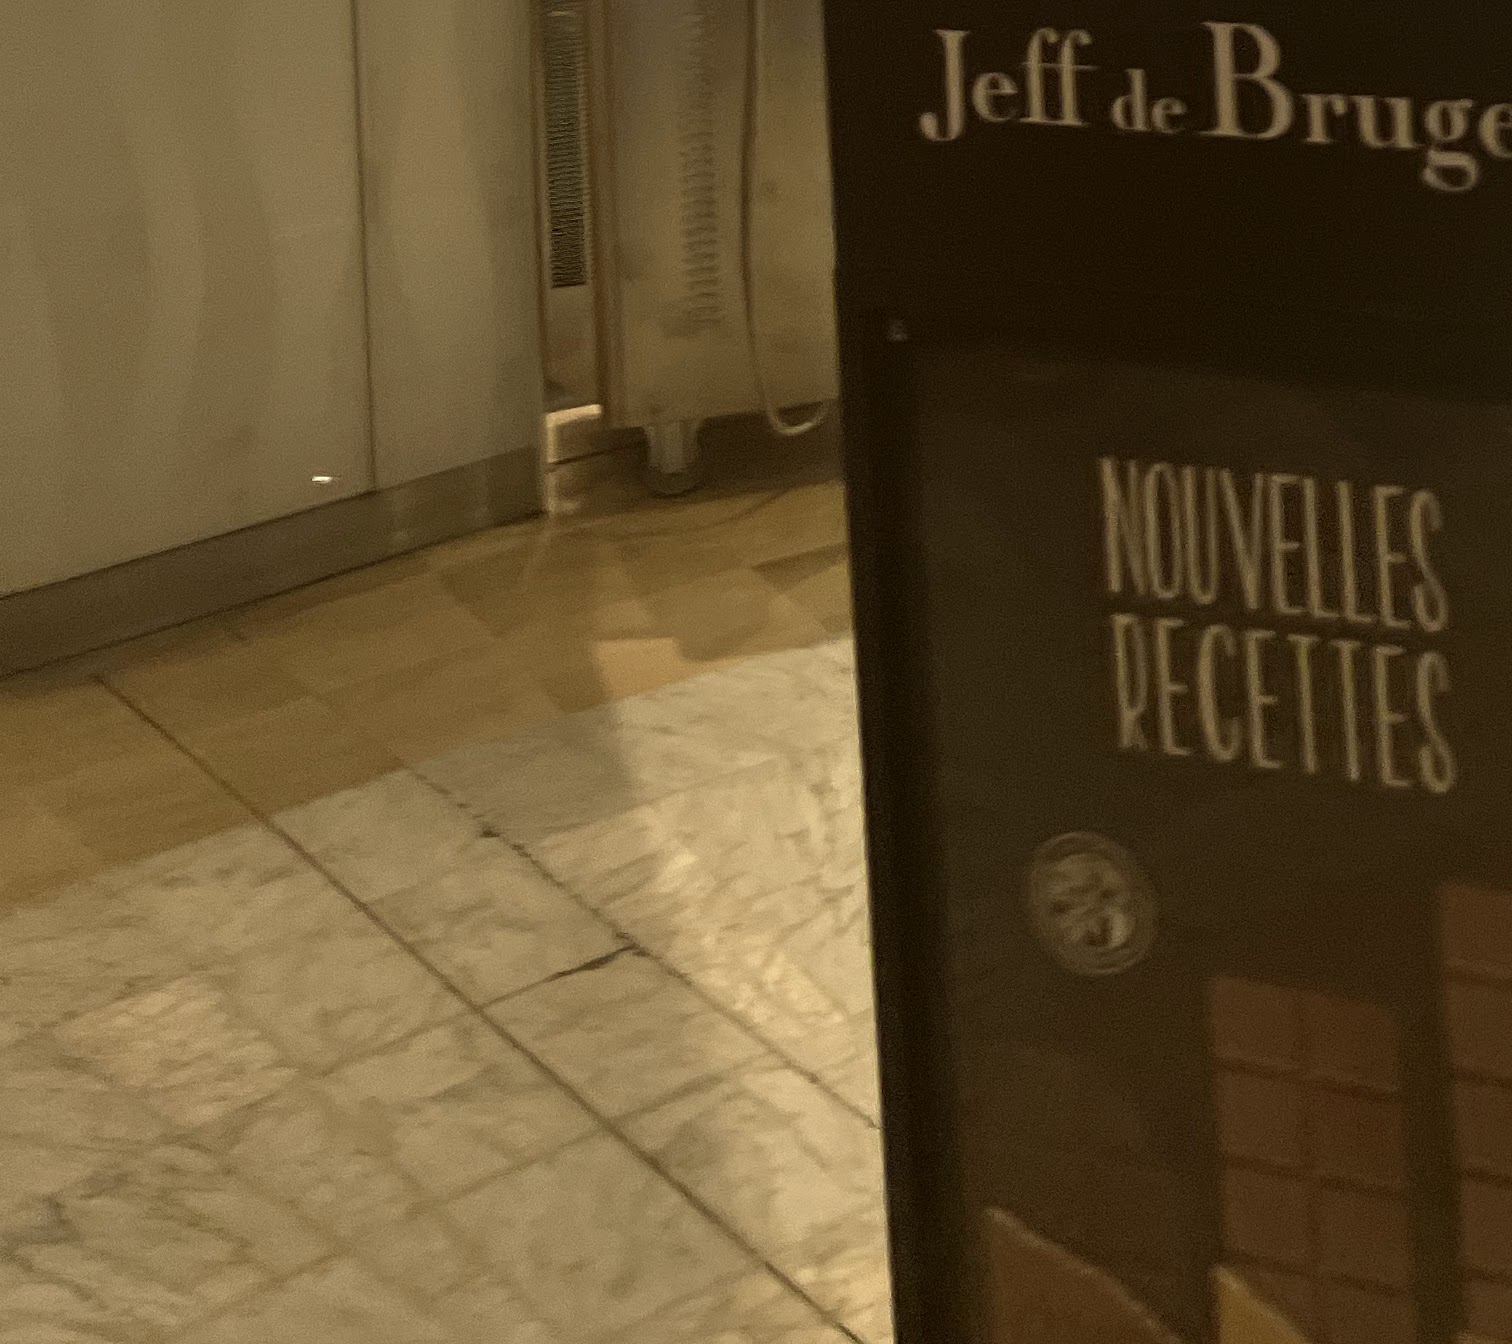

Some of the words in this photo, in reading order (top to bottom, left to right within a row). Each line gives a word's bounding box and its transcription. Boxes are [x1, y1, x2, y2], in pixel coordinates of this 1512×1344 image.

[919, 27, 1098, 143] Jeff
[1110, 69, 1188, 135] de
[1099, 456, 1450, 633] NOUVELLES
[1112, 613, 1459, 794] RECETTES
